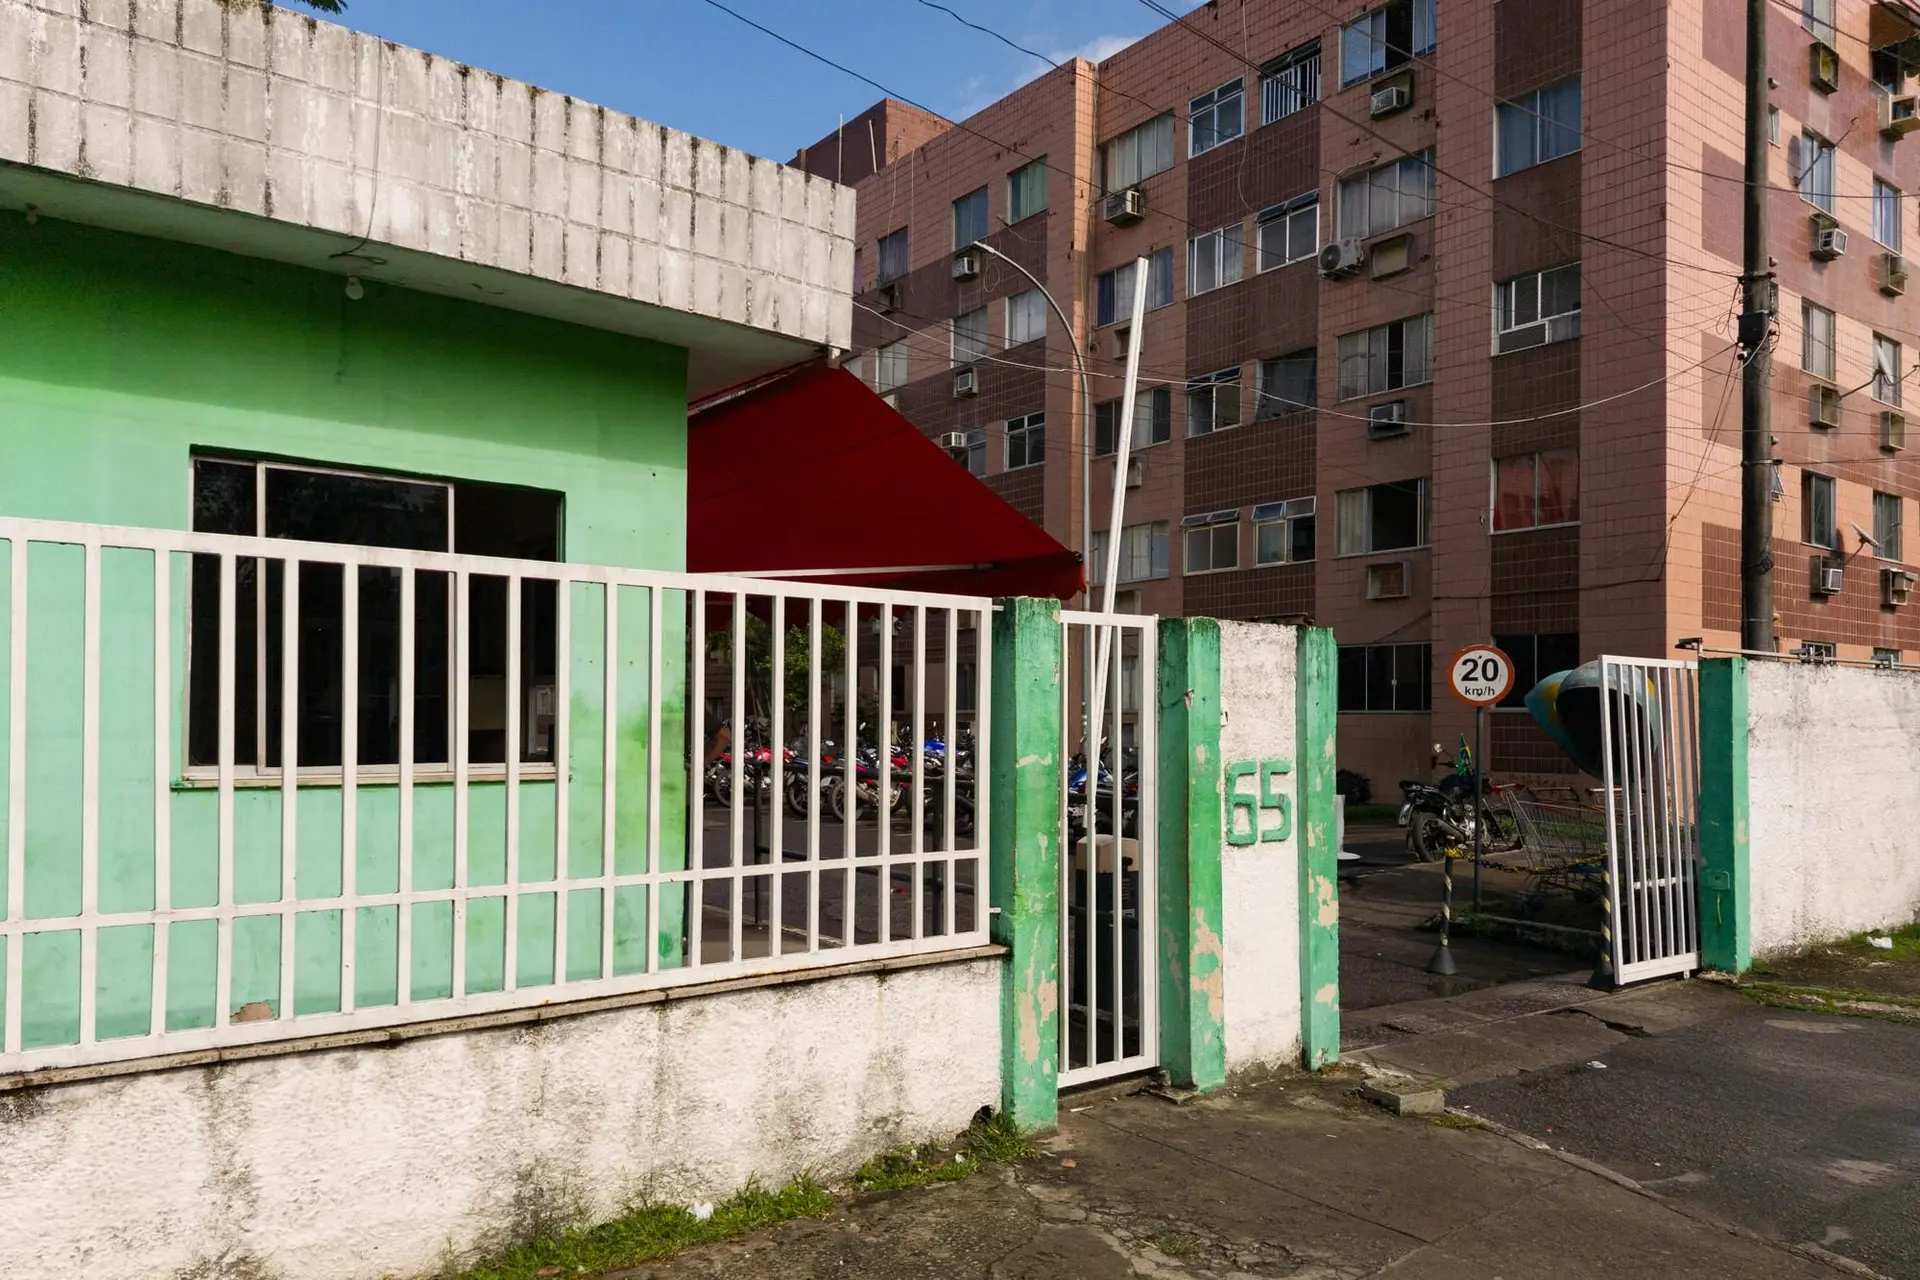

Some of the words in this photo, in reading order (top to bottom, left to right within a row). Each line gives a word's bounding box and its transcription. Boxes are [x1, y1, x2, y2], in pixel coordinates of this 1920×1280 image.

[1461, 658, 1499, 682] 20
[1464, 686, 1495, 696] km/h
[1226, 760, 1292, 846] 65
